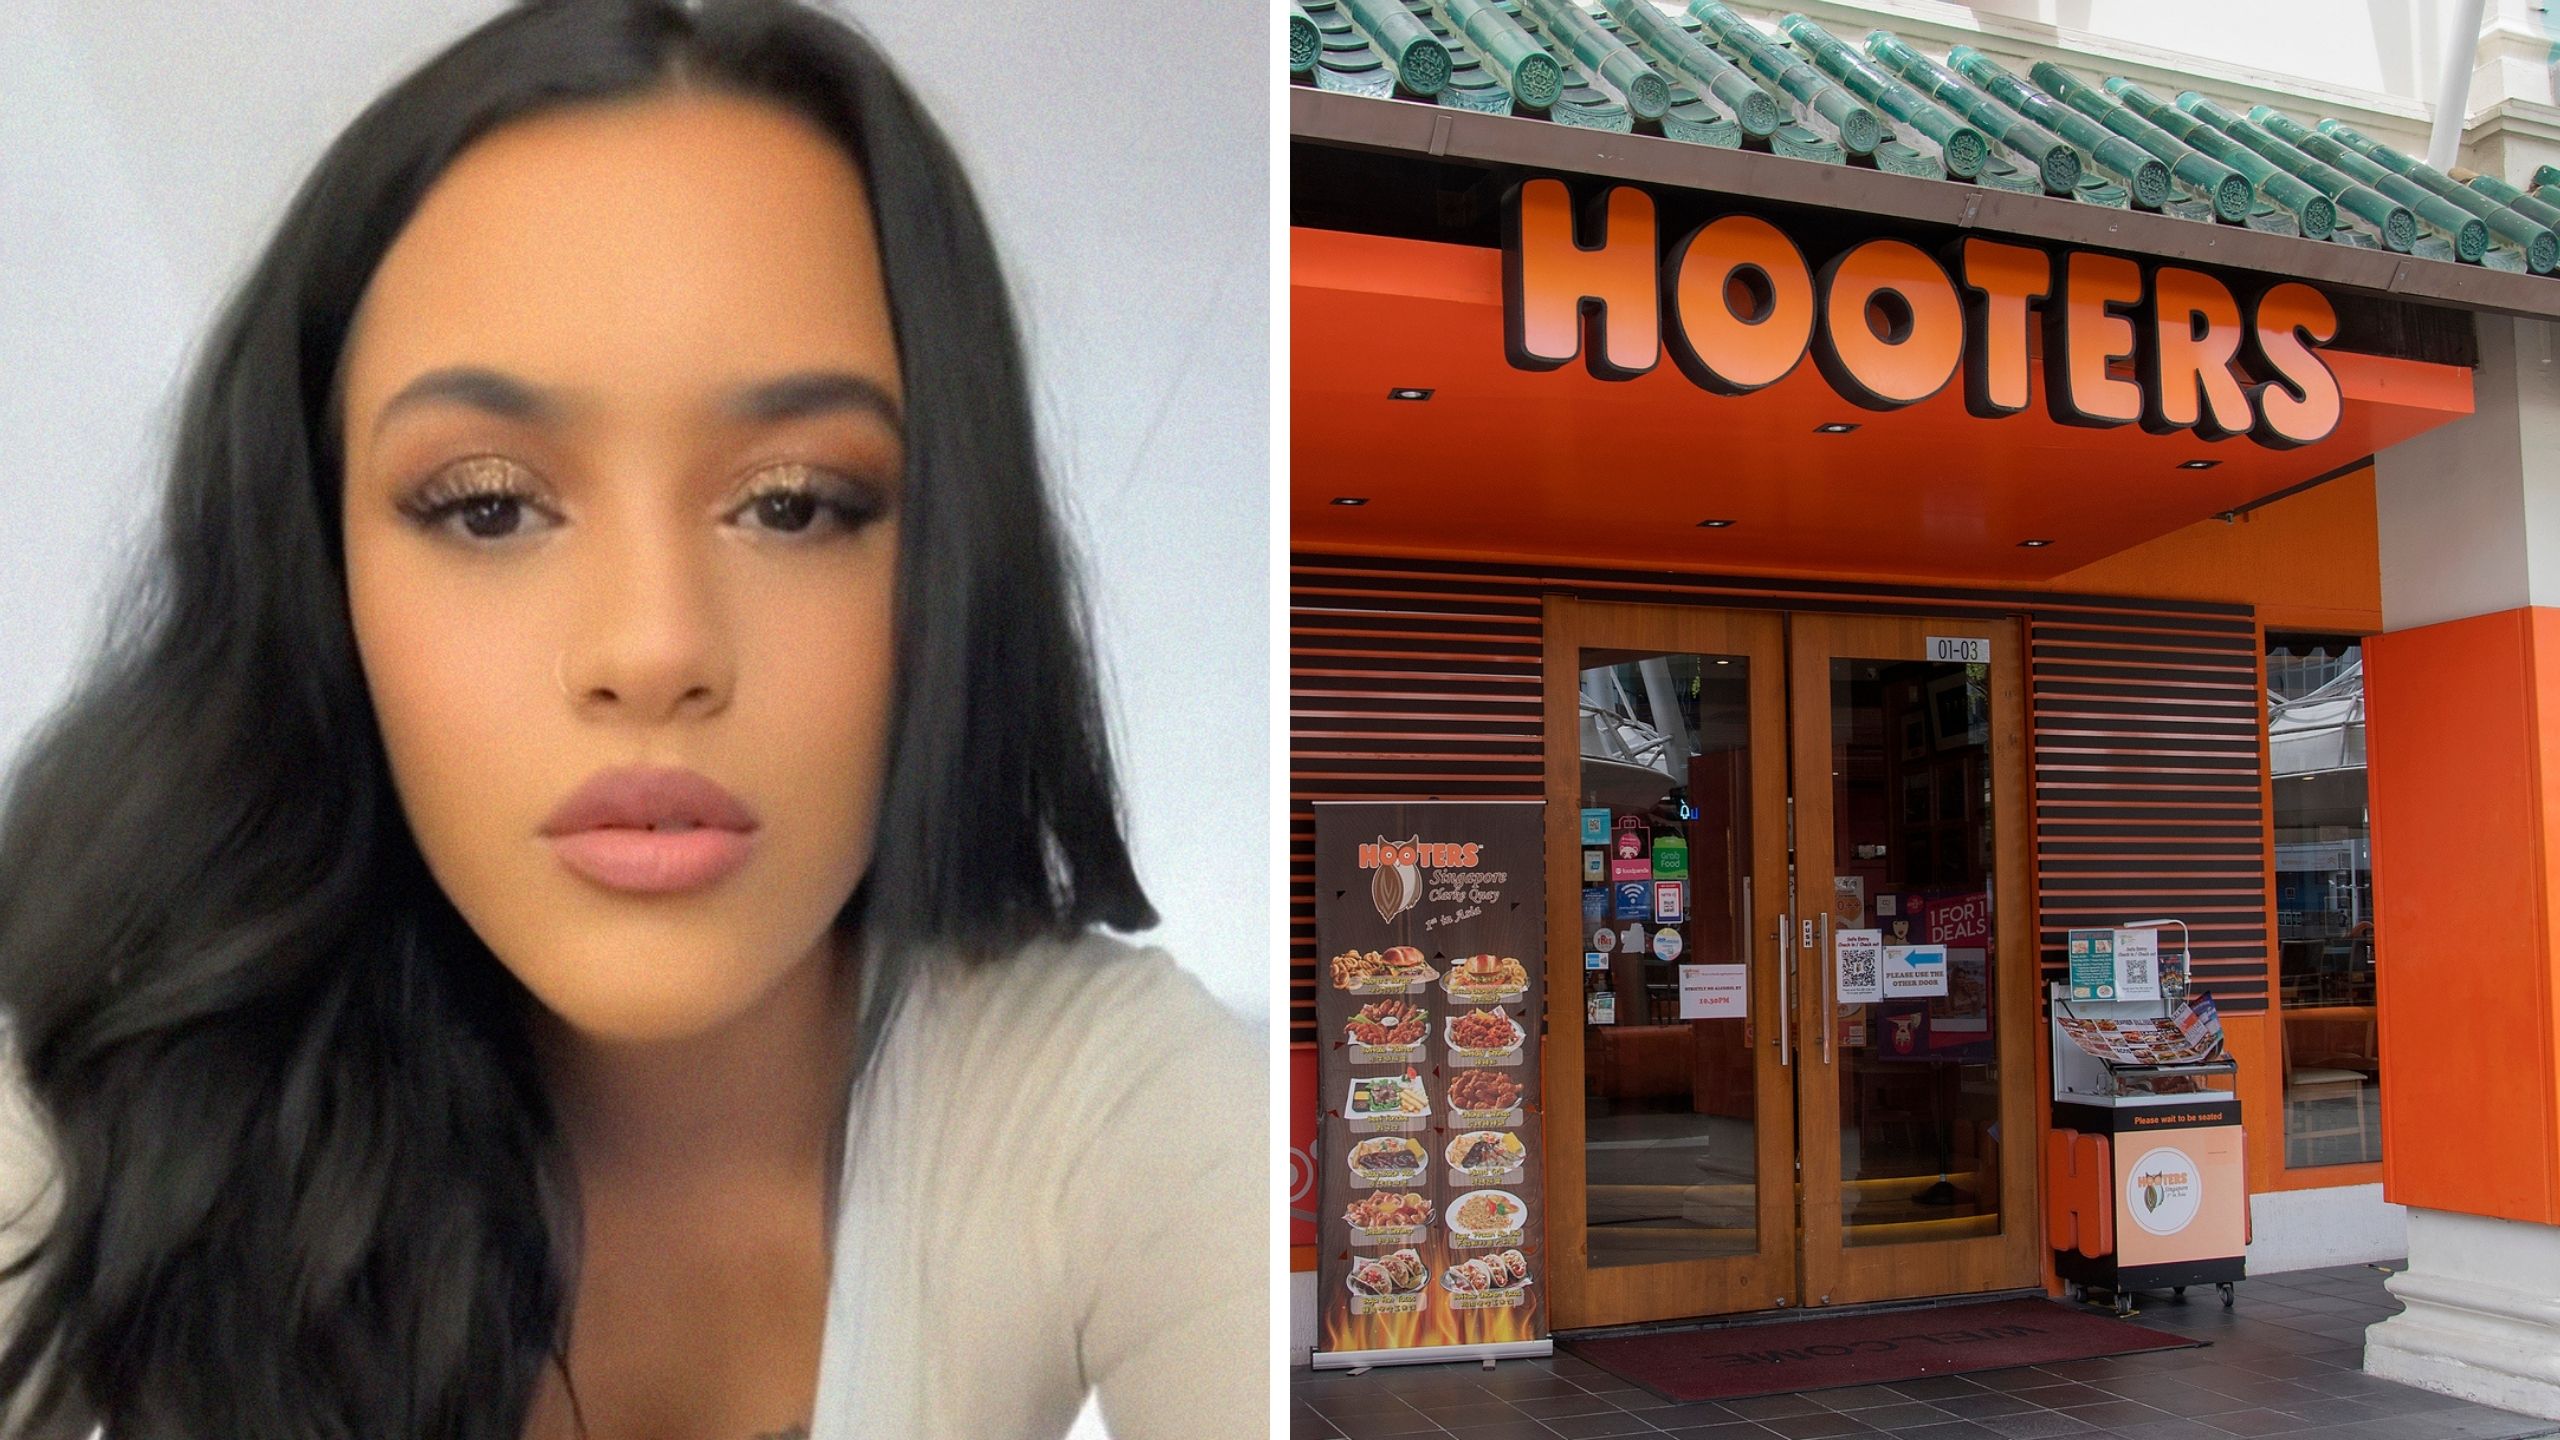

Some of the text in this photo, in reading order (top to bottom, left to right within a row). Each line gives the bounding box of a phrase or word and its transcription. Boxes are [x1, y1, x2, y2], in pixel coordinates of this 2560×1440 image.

[1502, 178, 2341, 448] HOOTERS
[1938, 640, 1978, 660] 01-03
[1359, 842, 1479, 868] HOOTERS
[1660, 851, 1680, 860] Grab
[1660, 860, 1680, 868] Food
[1429, 868, 1508, 889] Singapore
[1622, 867, 1649, 875] foodpanda
[1428, 886, 1500, 904] Clarke Quay
[1454, 905, 1482, 923] Asia
[1930, 910, 1936, 927] 1
[1939, 903, 1975, 925] FOR
[1979, 900, 1985, 917] 1
[1932, 918, 1987, 943] DEALS
[2134, 1116, 2159, 1125] Please
[2160, 1115, 2176, 1123] wait
[2198, 1112, 2223, 1121] seated
[2137, 1172, 2188, 1188] HOOTERS
[1703, 1324, 2049, 1366] WELCOME
